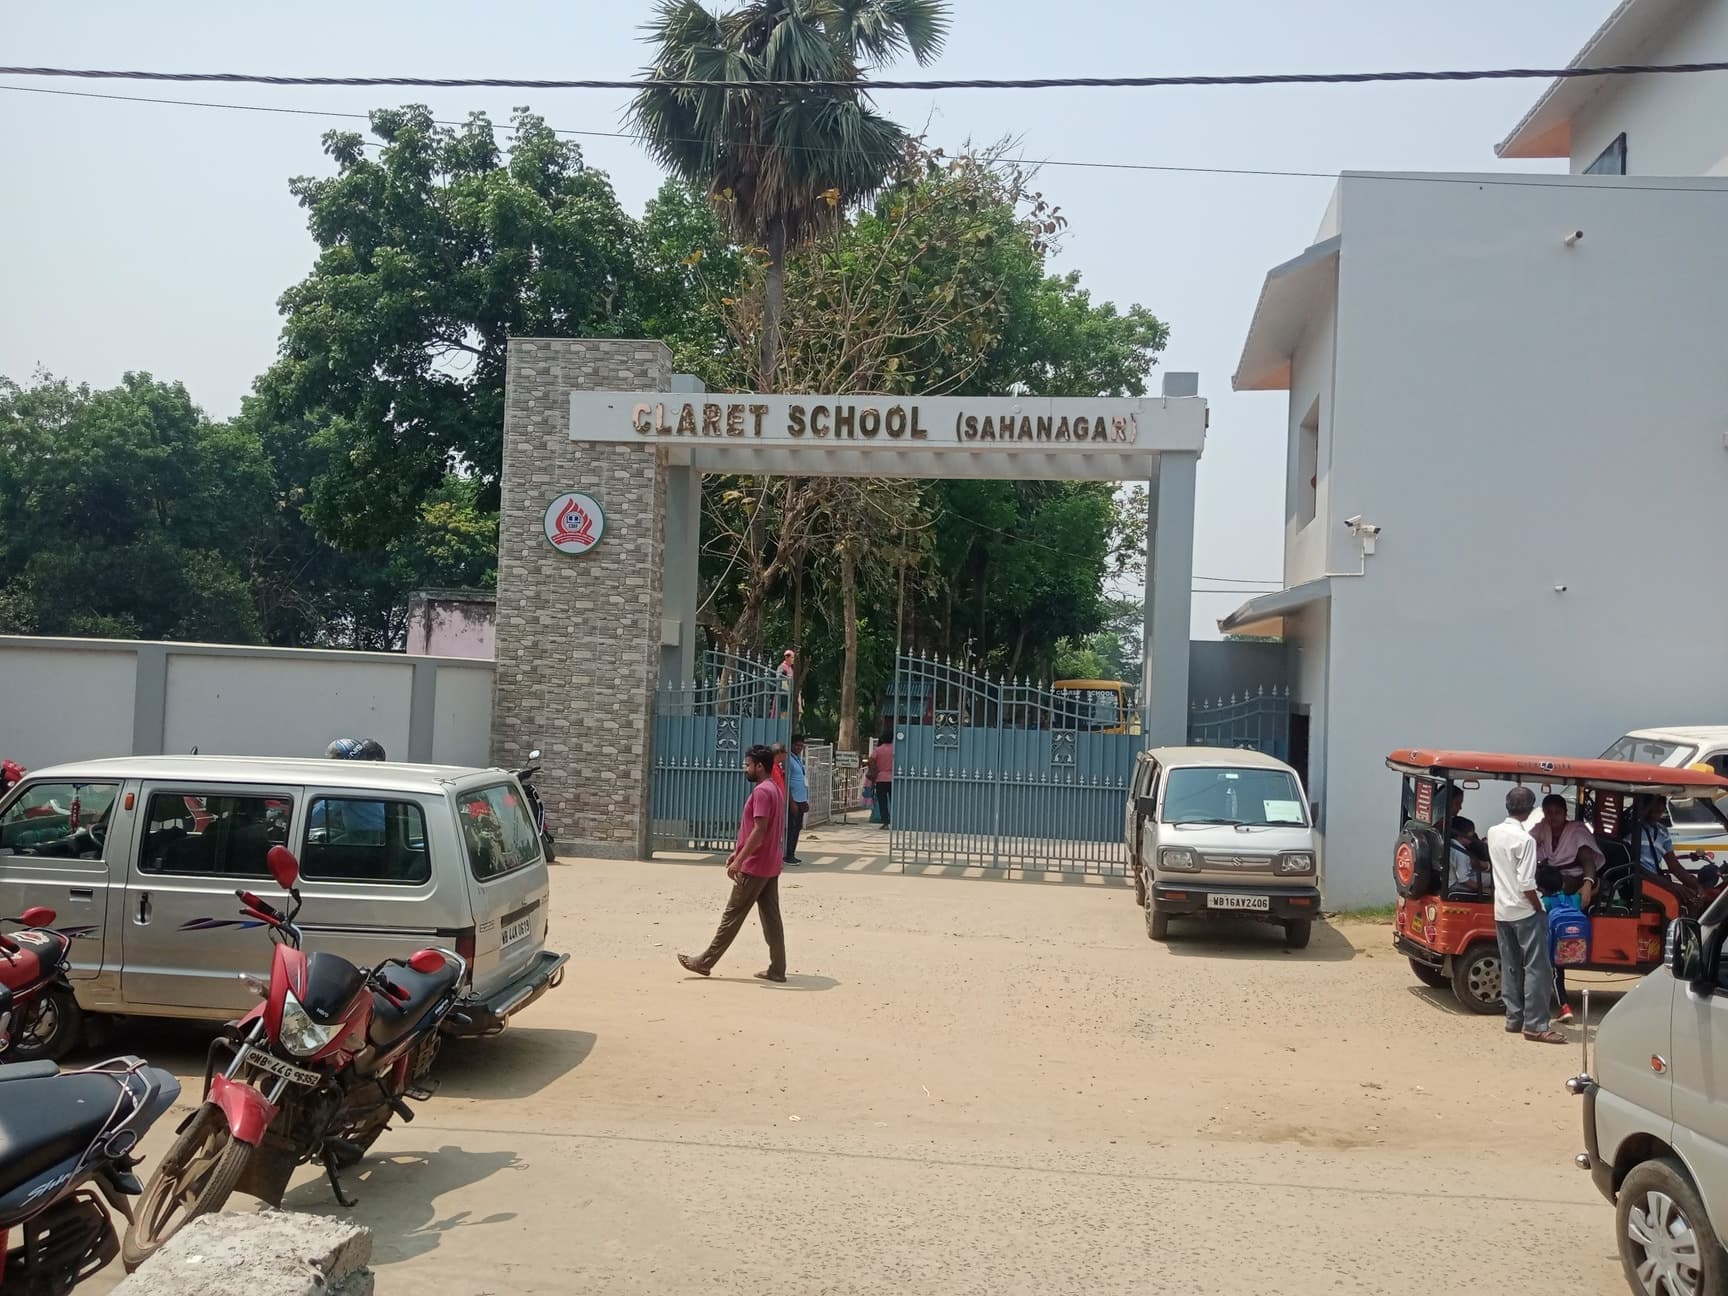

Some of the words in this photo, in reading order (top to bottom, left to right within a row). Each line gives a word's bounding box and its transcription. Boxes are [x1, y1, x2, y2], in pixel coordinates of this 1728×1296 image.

[632, 402, 768, 436] CLARET
[788, 404, 928, 439] SCHOOL
[956, 412, 1137, 443] (SAHANAGAR)
